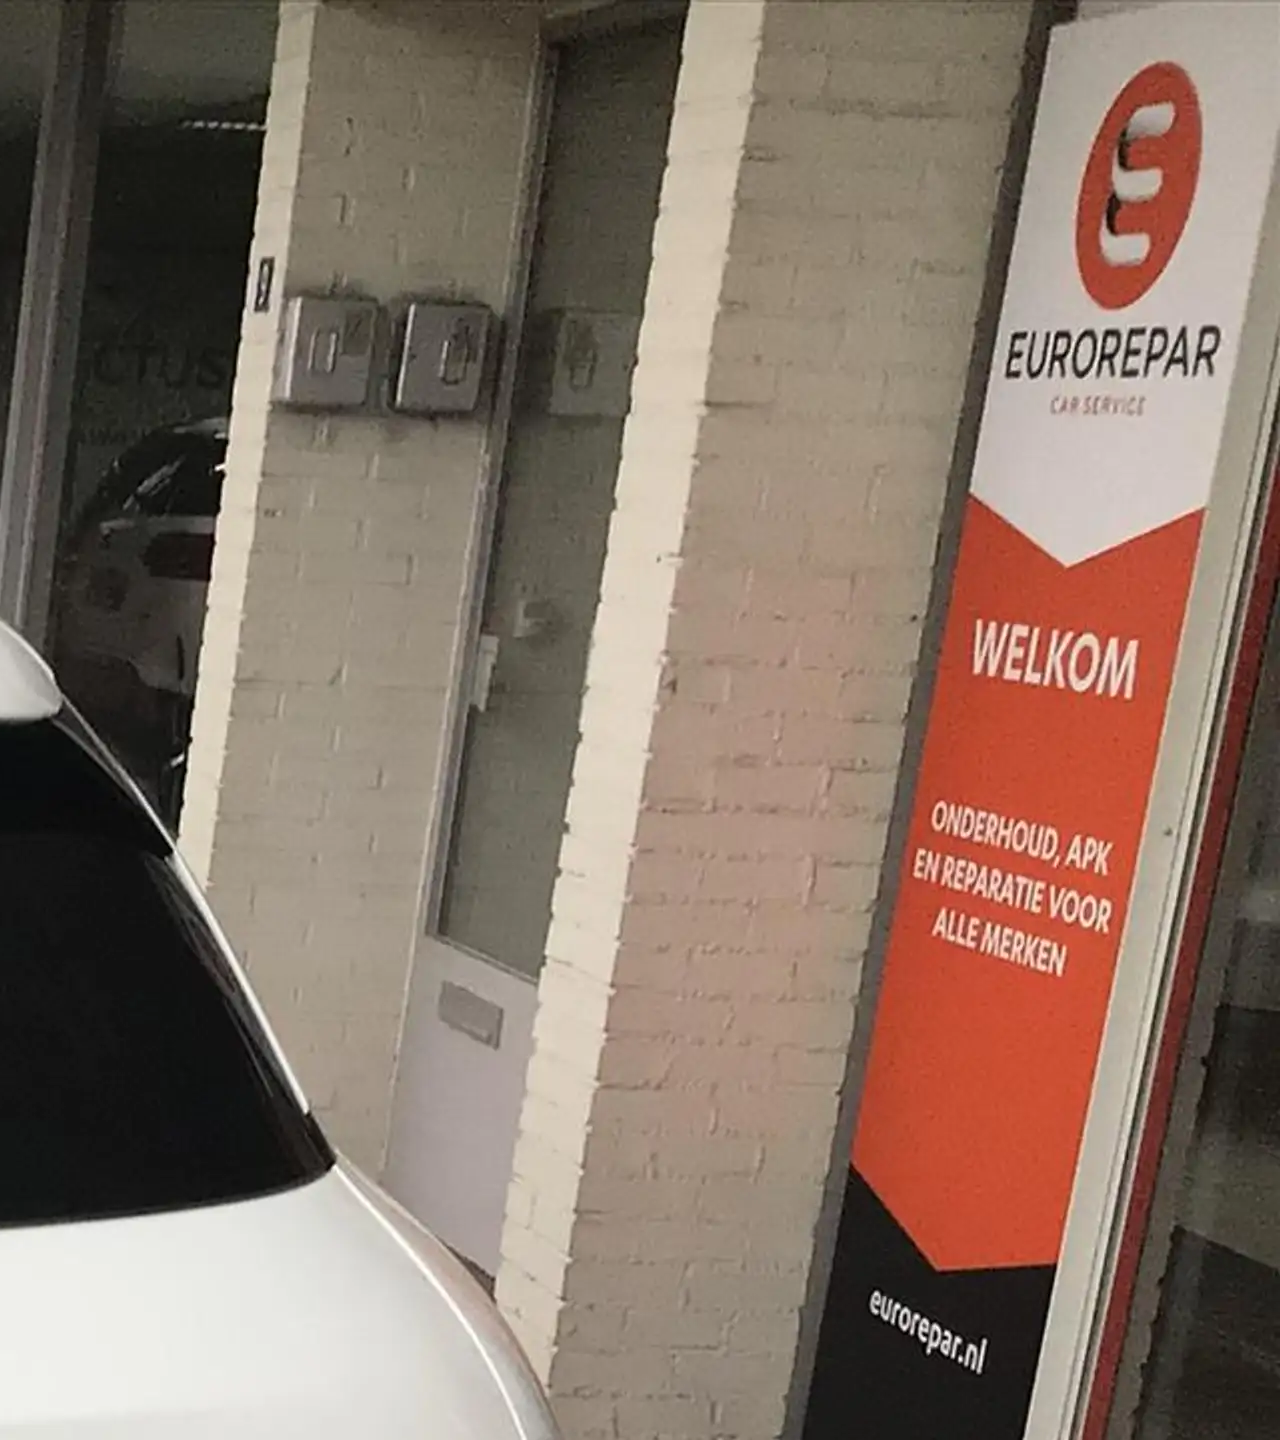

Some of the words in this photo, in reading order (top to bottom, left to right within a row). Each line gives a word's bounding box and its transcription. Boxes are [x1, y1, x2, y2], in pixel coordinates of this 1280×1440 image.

[1005, 325, 1221, 379] EUROREPAR
[1049, 395, 1078, 415] CAR
[1081, 394, 1147, 416] SERVICE
[972, 618, 1139, 699] WELKOM
[931, 800, 1061, 868] ONDERHOUD,
[1064, 834, 1113, 876] APK
[913, 848, 941, 883] EN
[941, 856, 1046, 914] REPARATIE
[1048, 884, 1113, 933] VOOR
[932, 907, 980, 949] ALLE
[979, 921, 1067, 977] MERKEN
[869, 1290, 988, 1375] eurorepar.nl
